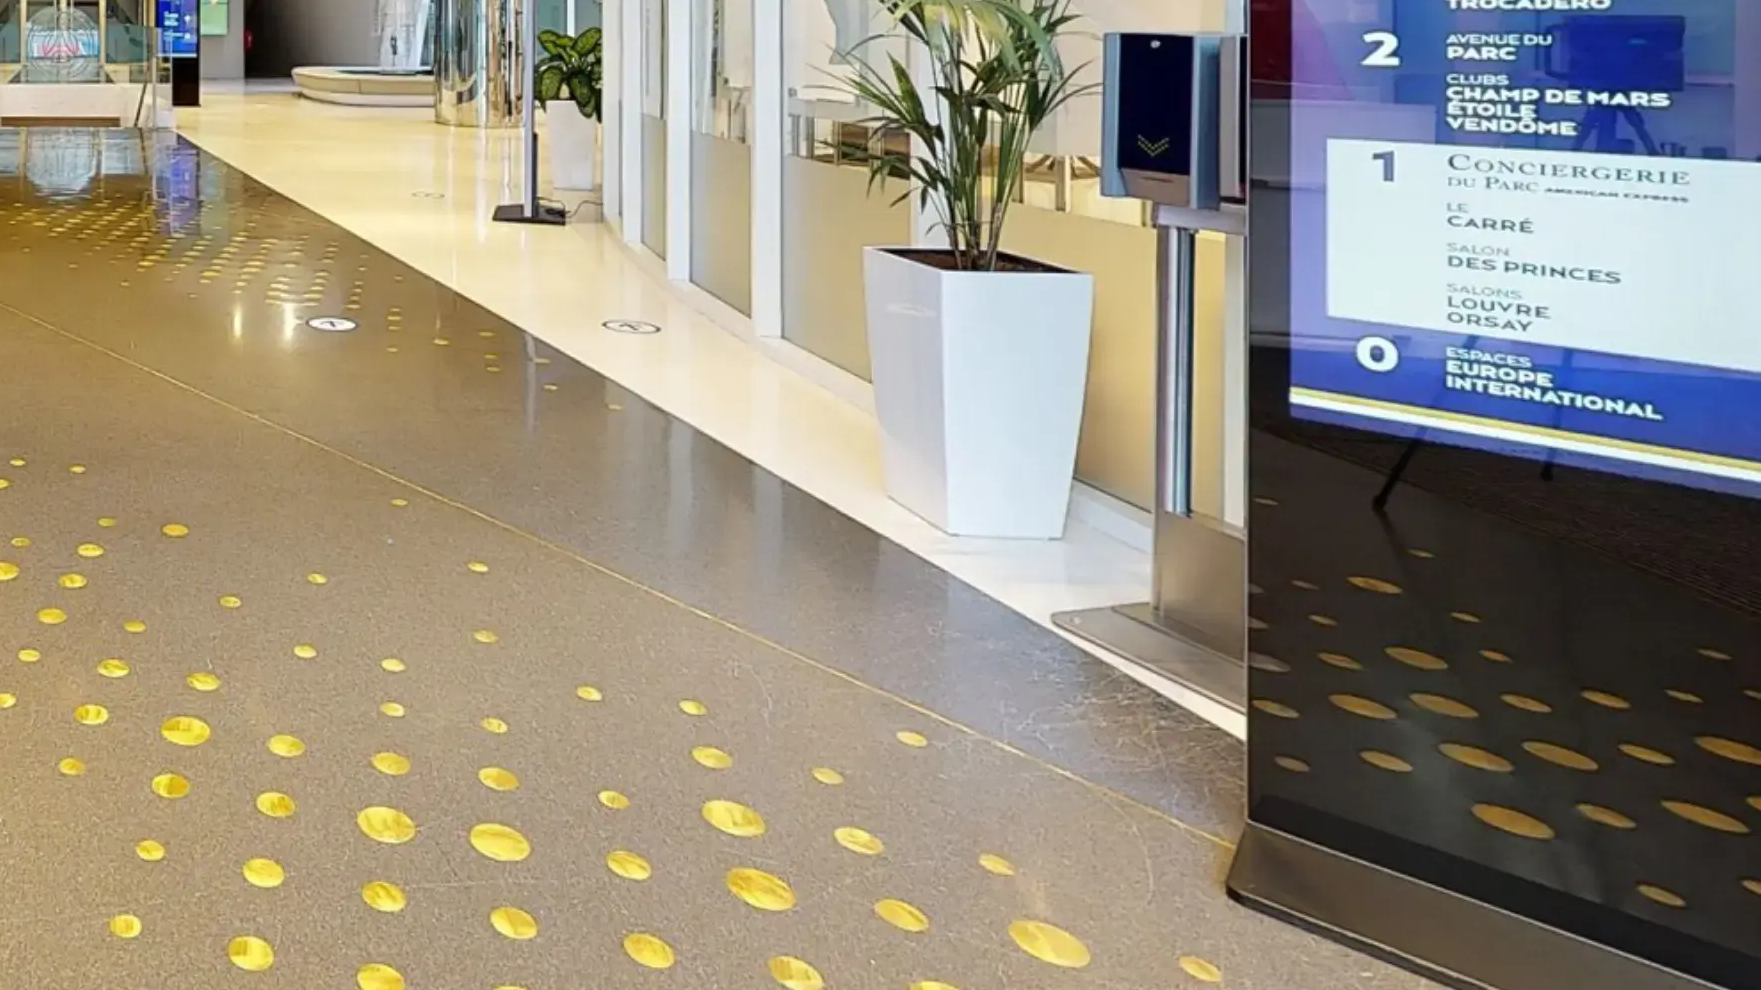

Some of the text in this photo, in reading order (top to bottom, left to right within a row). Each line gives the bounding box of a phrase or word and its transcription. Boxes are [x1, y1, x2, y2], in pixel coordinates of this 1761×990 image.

[1360, 32, 1400, 66] 2
[1446, 34, 1553, 46] AVENUE DU
[1446, 47, 1516, 60] PARC
[1446, 74, 1509, 85] CLUBS
[1446, 87, 1671, 107] CHAMP DE MARS
[1447, 99, 1538, 118] ÉTOILE
[1446, 116, 1578, 136] VENDÔME
[1372, 150, 1395, 182] 1
[1448, 153, 1690, 185] CONCIERGERIE
[1448, 177, 1476, 188] DU
[1485, 176, 1539, 193] PARC
[1447, 203, 1469, 213] LE
[1448, 215, 1534, 233] CARRÉ
[1447, 242, 1510, 257] SALON
[1447, 256, 1621, 284] DES PRINCES
[1447, 283, 1522, 299] SALONS
[1447, 296, 1551, 319] LOUVRE
[1447, 311, 1532, 332] ORSAY
[1356, 336, 1398, 372] 0
[1446, 346, 1532, 369] ESPACES
[1446, 360, 1554, 388] EUROPE
[1446, 374, 1664, 421] INTERNATIONAL
